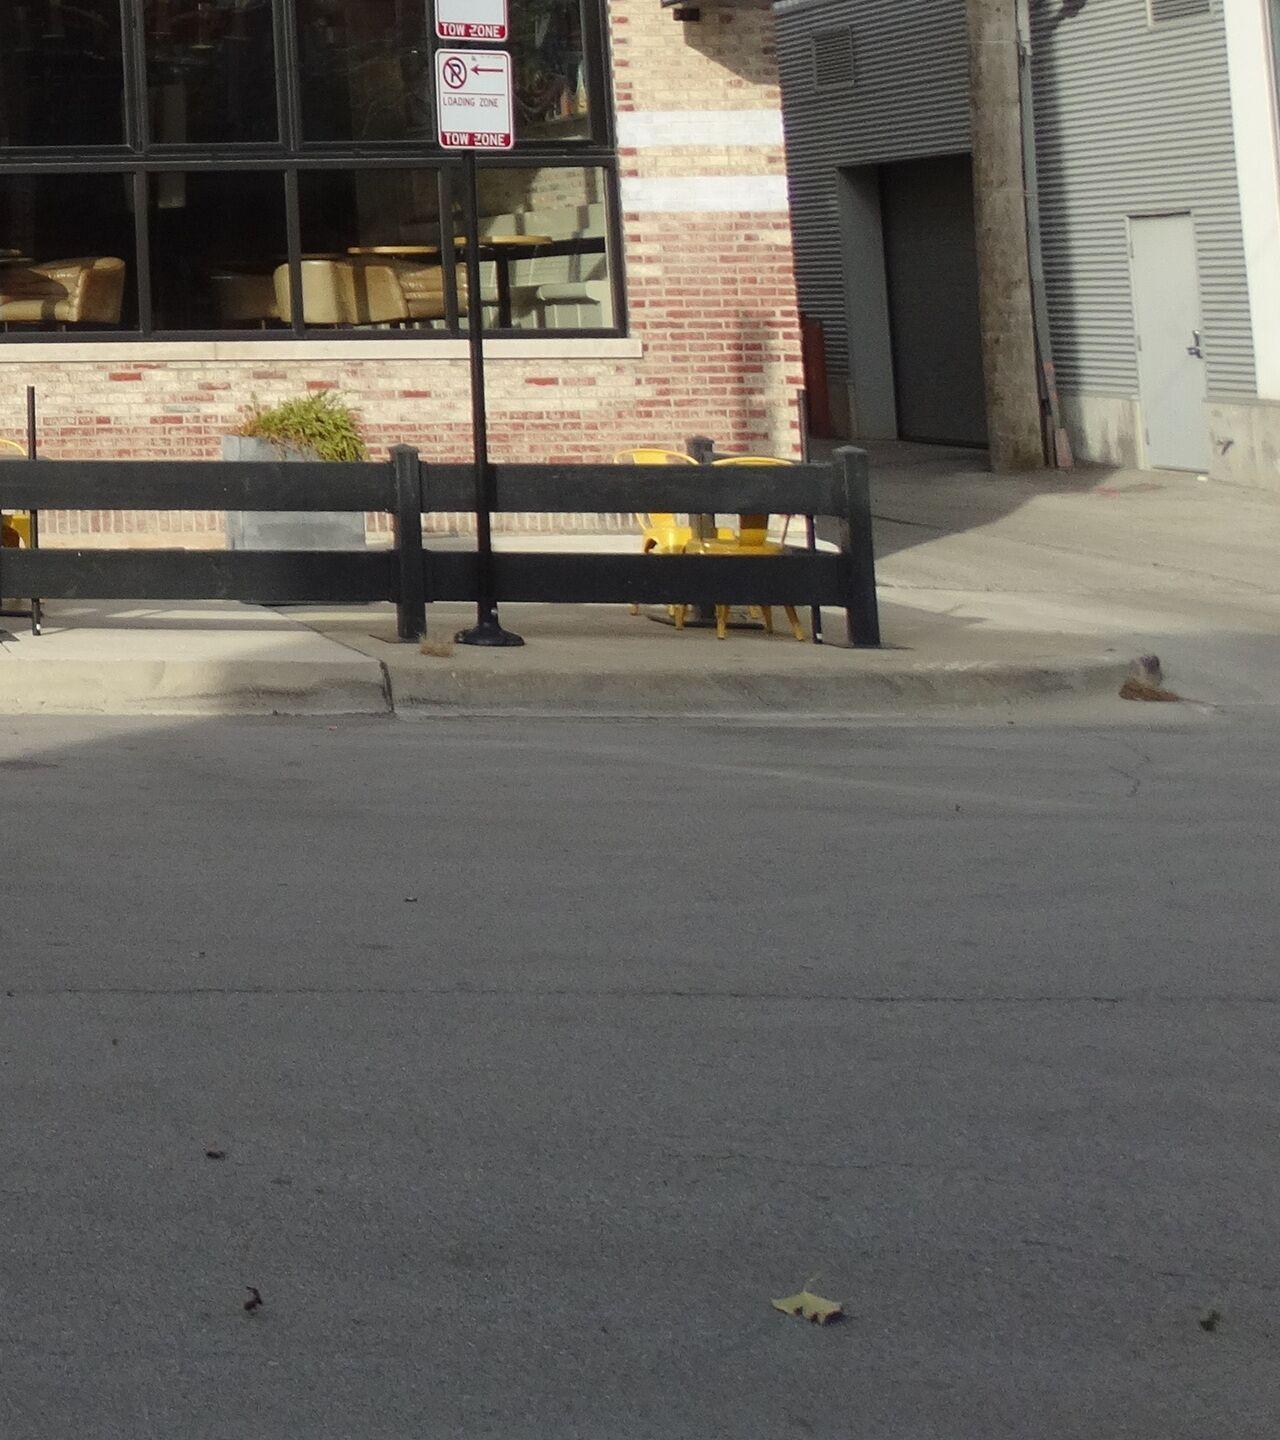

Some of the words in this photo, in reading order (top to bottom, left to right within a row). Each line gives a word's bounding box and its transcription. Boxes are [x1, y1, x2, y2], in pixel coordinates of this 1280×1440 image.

[440, 23, 466, 37] TOW
[469, 24, 502, 38] ZONE
[442, 96, 476, 107] LOADING
[479, 97, 499, 108] ZONE
[444, 133, 470, 146] TOW
[473, 133, 506, 147] ZONE
